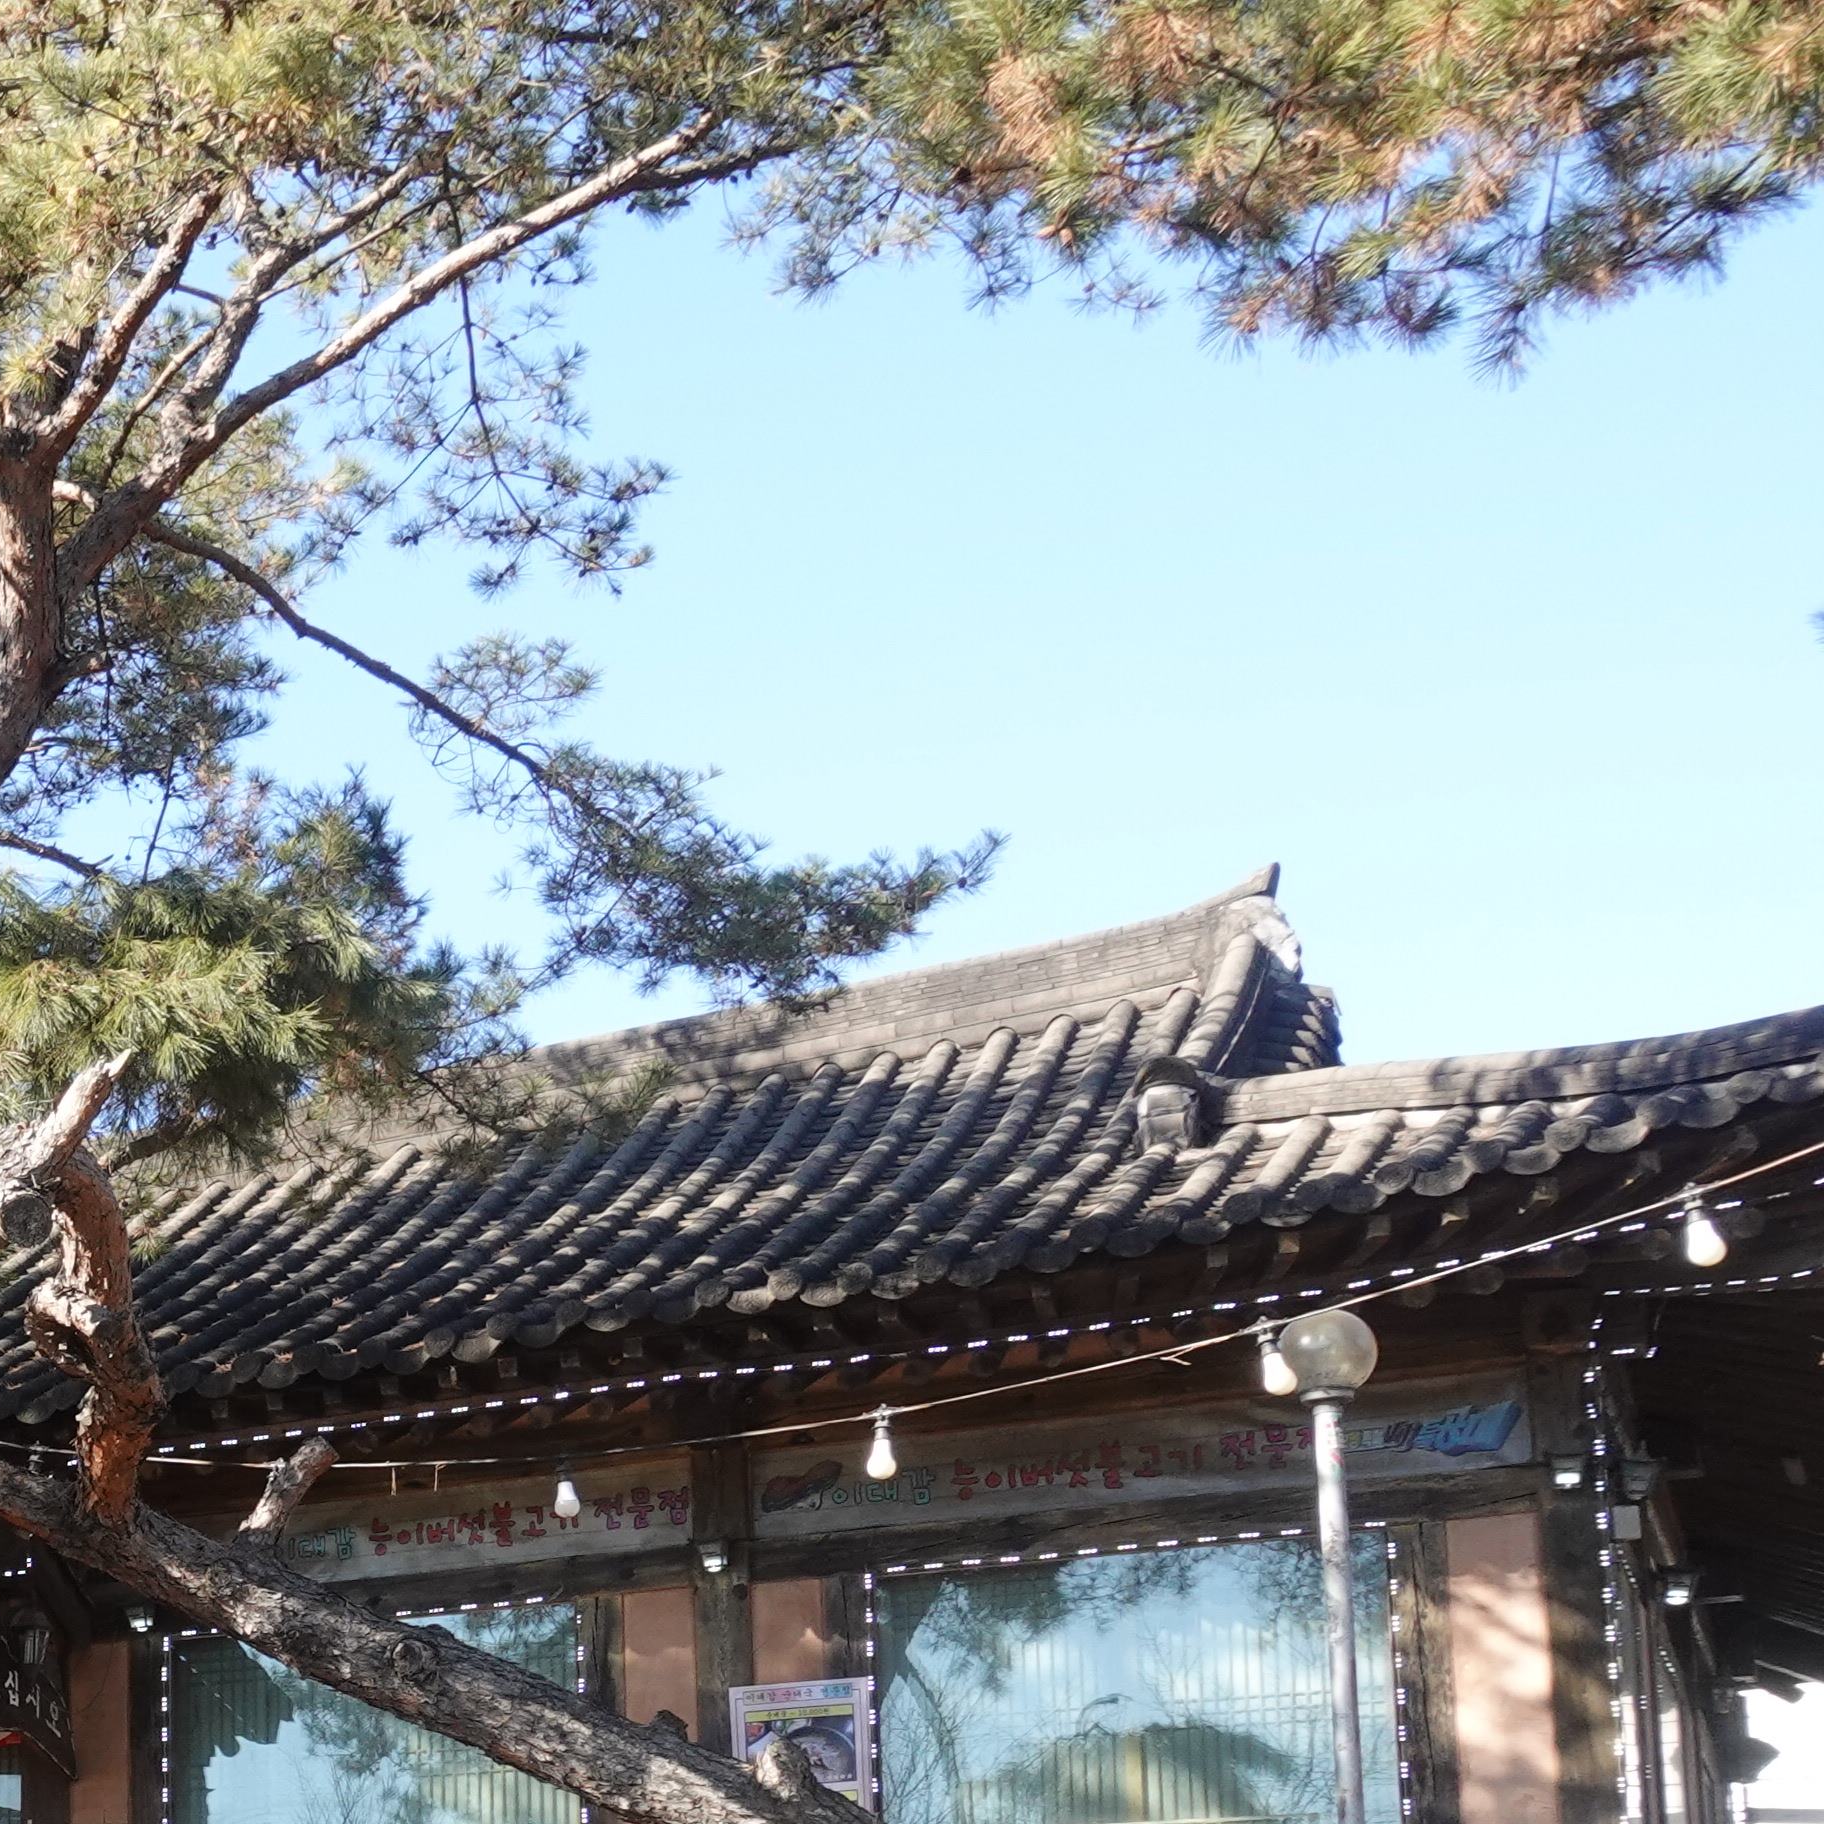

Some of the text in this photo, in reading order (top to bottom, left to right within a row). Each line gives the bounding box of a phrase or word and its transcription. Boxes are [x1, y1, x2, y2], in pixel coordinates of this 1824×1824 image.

[832, 1468, 936, 1505] 이대감
[950, 1440, 1204, 1500] 능이버섯불고기
[593, 1486, 691, 1531] 전문점
